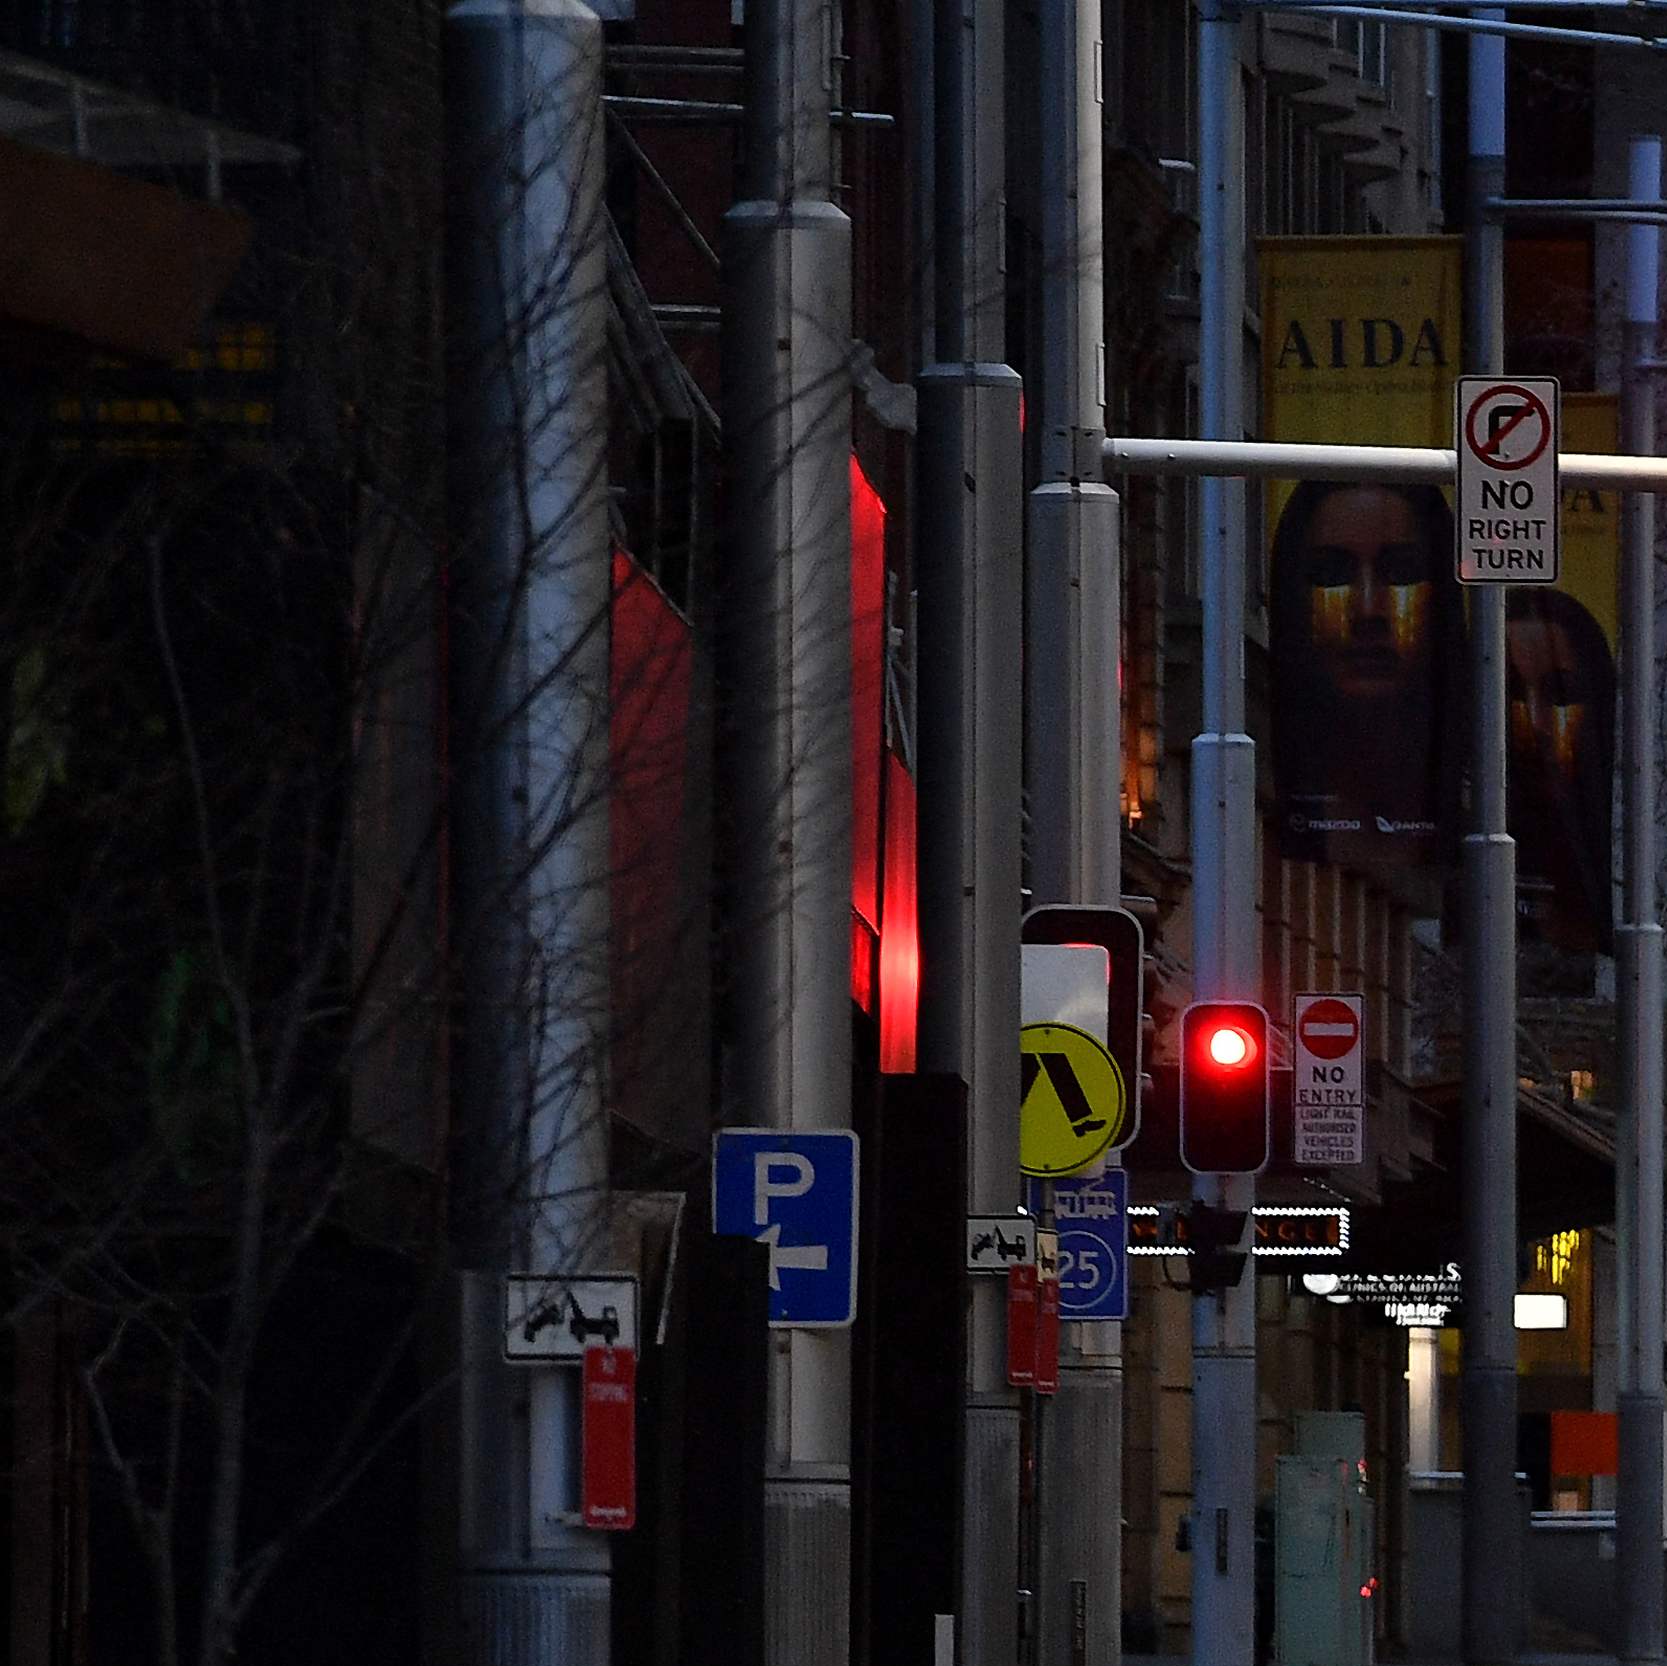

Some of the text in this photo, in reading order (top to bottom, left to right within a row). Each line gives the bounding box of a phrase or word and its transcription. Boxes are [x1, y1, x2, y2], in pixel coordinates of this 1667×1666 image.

[1276, 318, 1449, 369] AIDA
[1481, 480, 1534, 510] NO
[1468, 520, 1546, 541] RIGHT
[1472, 548, 1544, 570] TURN
[1312, 1066, 1344, 1083] NO
[1299, 1089, 1356, 1103] ENTRY
[1300, 1109, 1356, 1119] LIGHT RAIL
[1304, 1136, 1354, 1147] VEHICLES
[1302, 1150, 1354, 1161] EXCEPTED
[754, 1152, 816, 1226] P
[1058, 1251, 1101, 1289] 25
